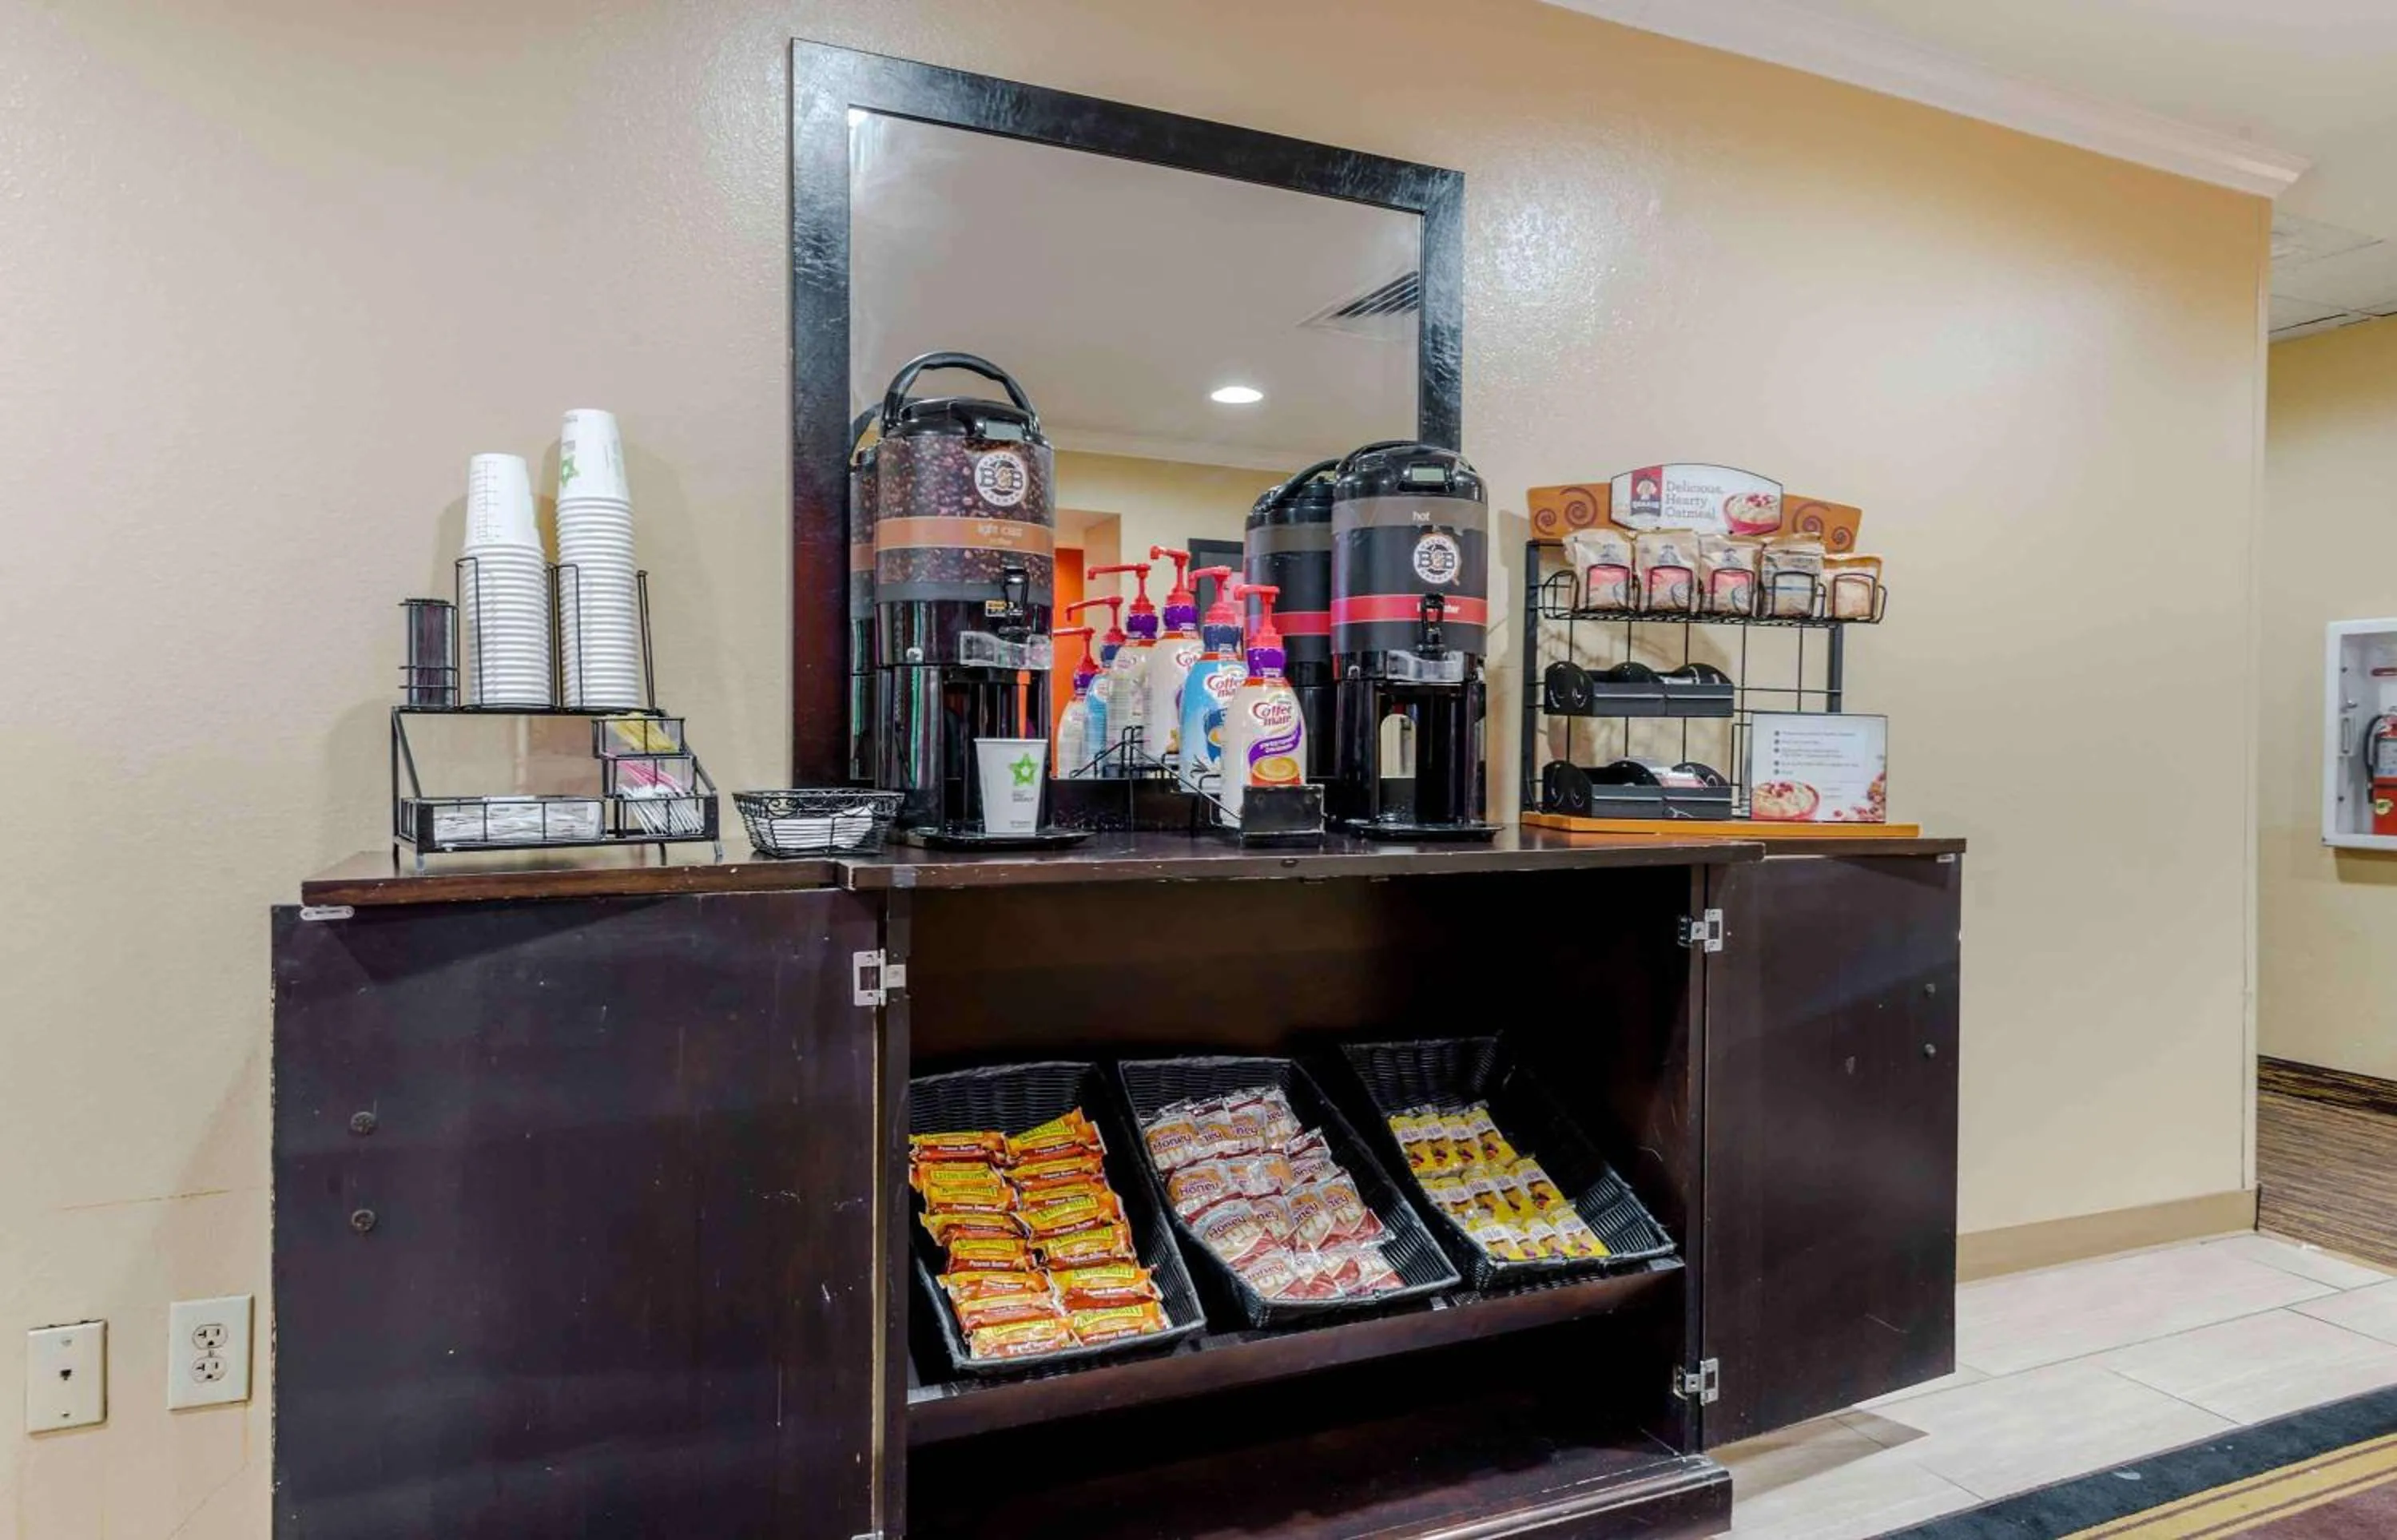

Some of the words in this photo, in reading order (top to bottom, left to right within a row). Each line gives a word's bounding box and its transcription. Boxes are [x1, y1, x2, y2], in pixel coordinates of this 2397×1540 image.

[1412, 511, 1431, 522] hot
[1253, 701, 1292, 719] Coffee
[1151, 1133, 1193, 1152] Honey
[1293, 1161, 1324, 1177] oney
[1179, 1181, 1220, 1197] Honey
[1294, 1202, 1318, 1225] oney
